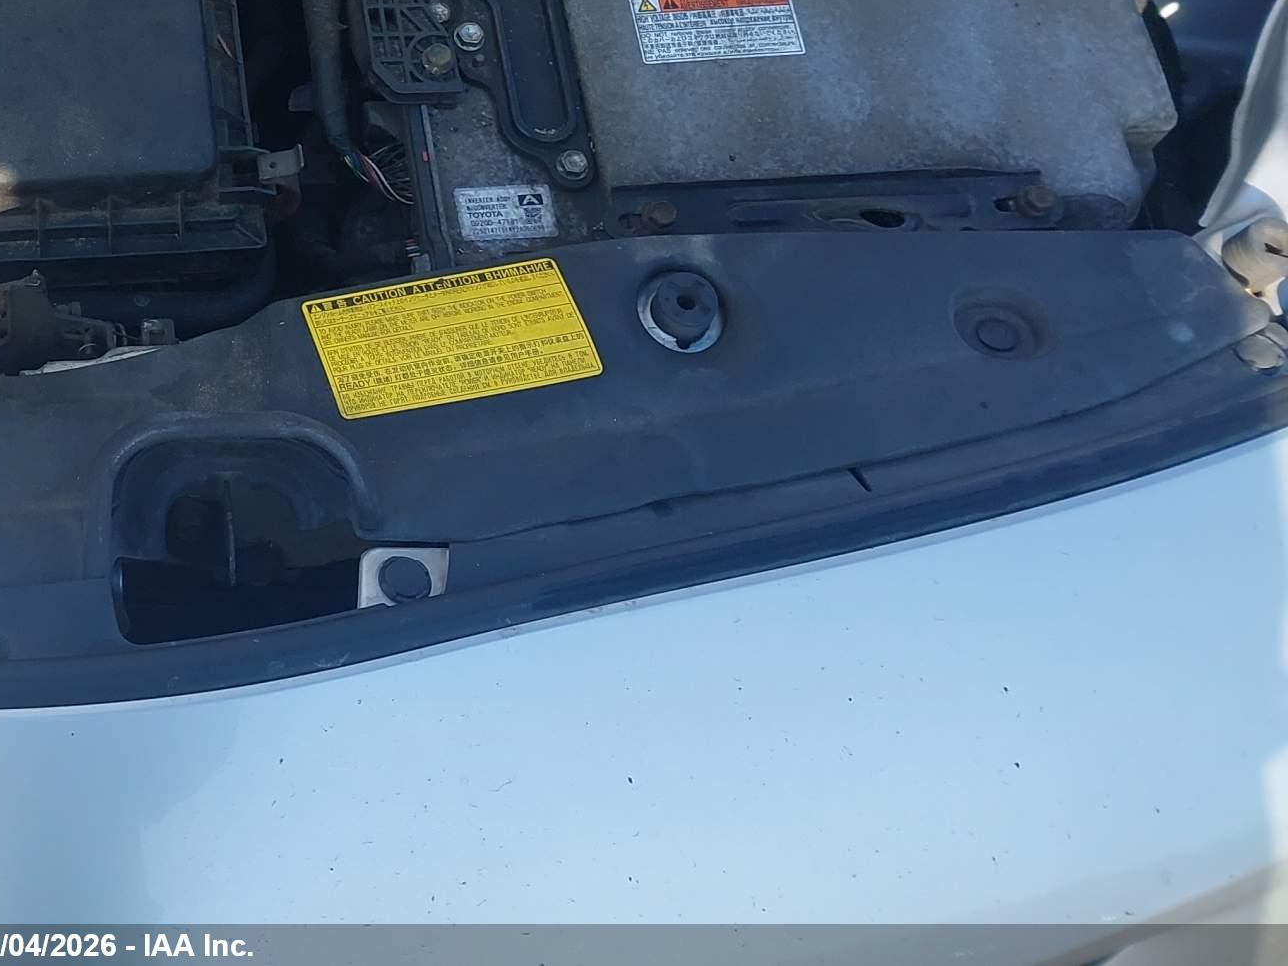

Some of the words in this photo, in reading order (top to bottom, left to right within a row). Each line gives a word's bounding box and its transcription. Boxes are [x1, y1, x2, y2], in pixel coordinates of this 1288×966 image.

[466, 210, 504, 219] TOYOTA
[351, 287, 407, 304] CAUTION
[411, 275, 481, 294] ATTENTION
[484, 261, 551, 280] ВНИМАНИЕ
[338, 379, 371, 391] READY
